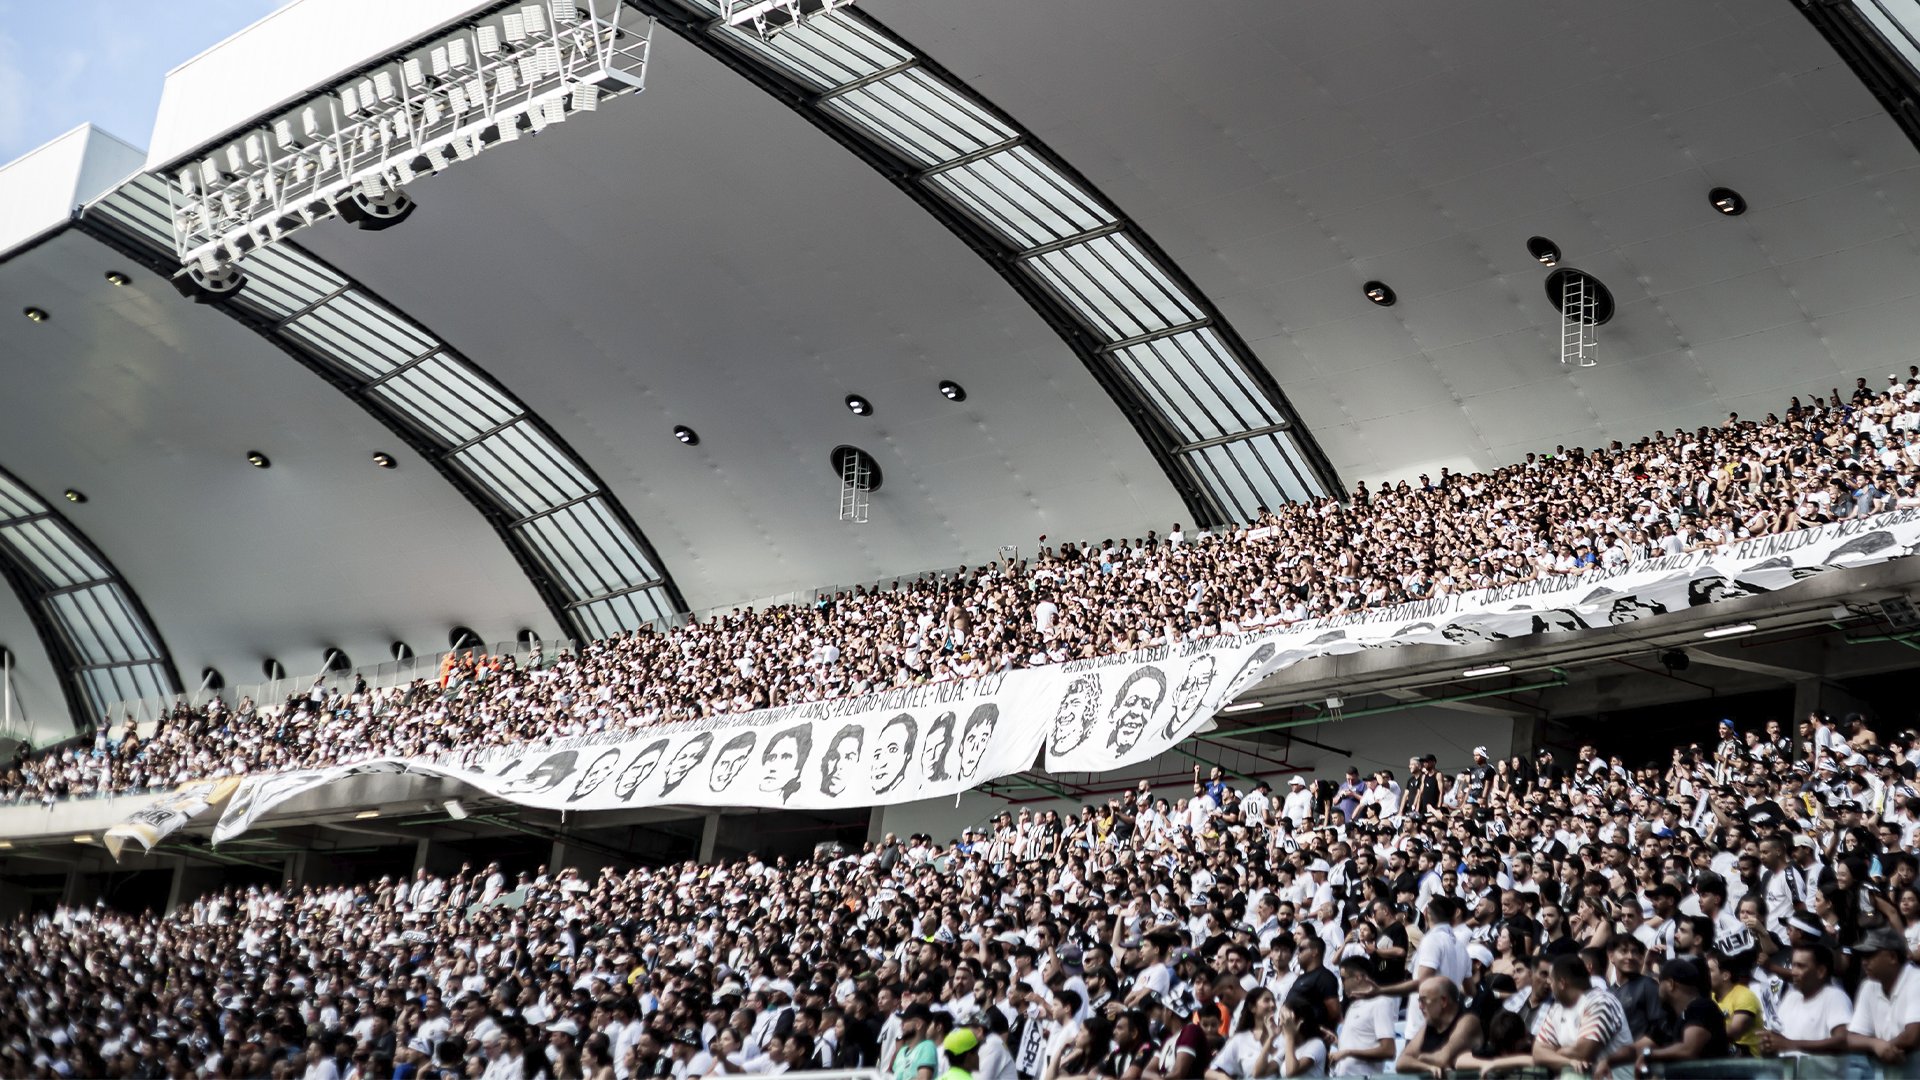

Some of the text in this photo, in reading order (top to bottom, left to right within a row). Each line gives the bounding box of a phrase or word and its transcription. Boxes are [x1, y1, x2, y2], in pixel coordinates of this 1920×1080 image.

[1097, 651, 1128, 669] CHAGAS
[1132, 645, 1169, 664] ALBERI
[1213, 633, 1242, 649] ALVES
[1371, 595, 1450, 623] FERDINANDO
[1480, 587, 1516, 606] JORGE
[1517, 574, 1580, 598] DEMOLIDOR
[1587, 562, 1630, 585] EDSON
[1638, 553, 1693, 573] DANILO
[1696, 549, 1714, 567] M.
[1737, 526, 1823, 560] REINALDO
[800, 701, 832, 721] LAMAS
[880, 687, 920, 712] VICENTE
[1247, 801, 1258, 816] 10
